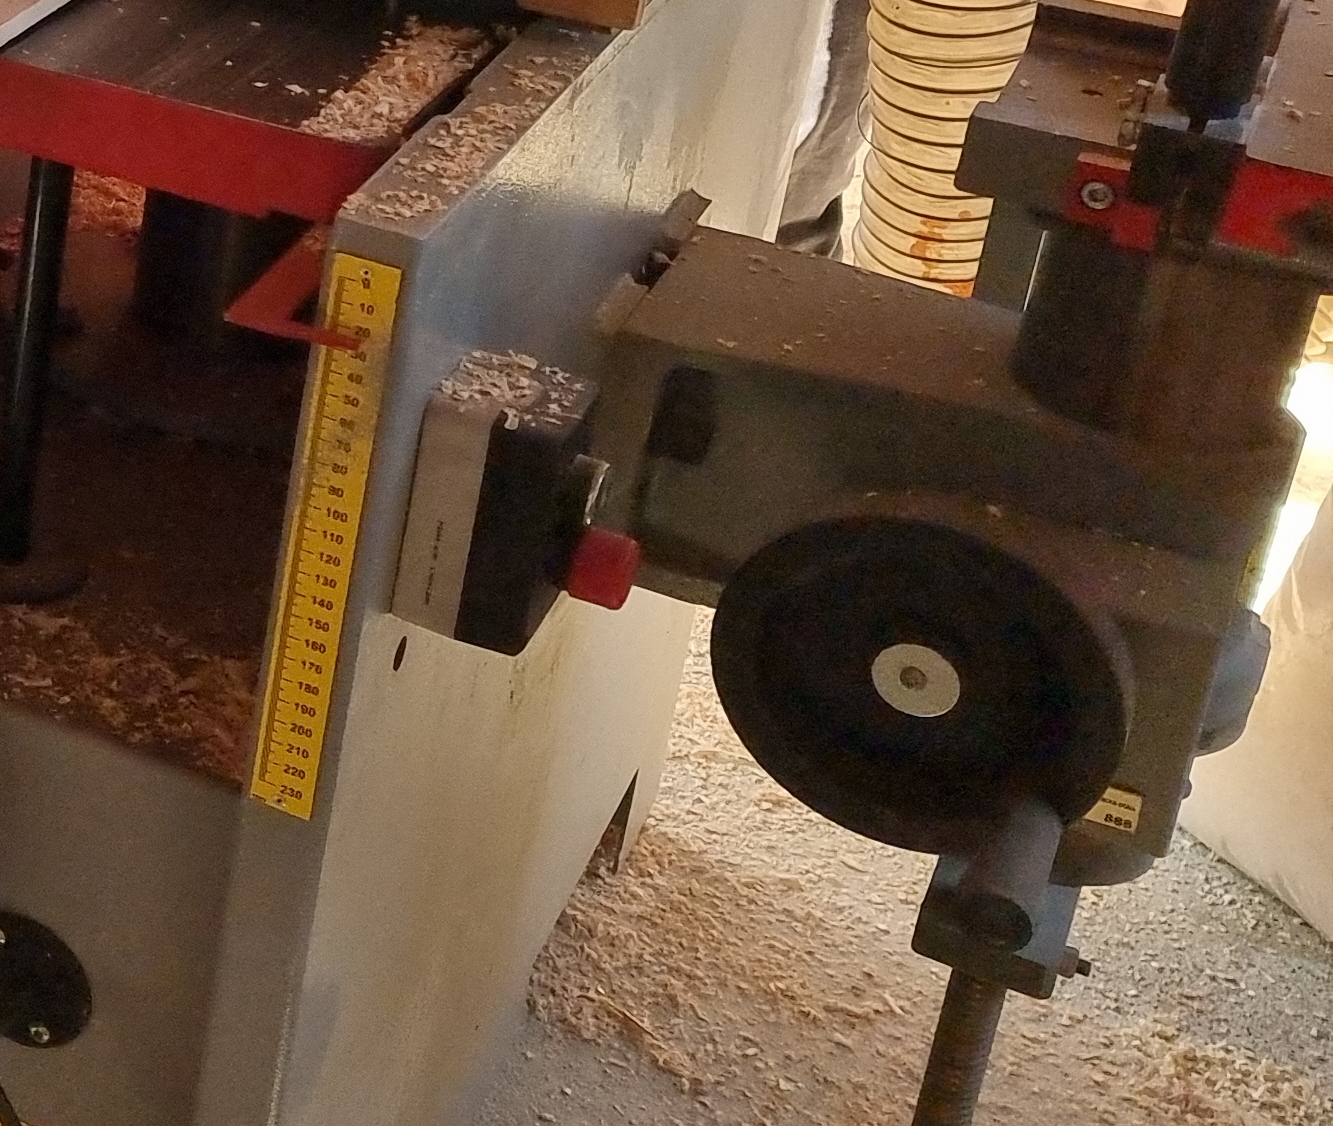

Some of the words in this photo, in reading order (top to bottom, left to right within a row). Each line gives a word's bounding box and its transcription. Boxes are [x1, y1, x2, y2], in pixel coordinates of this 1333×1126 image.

[359, 302, 375, 315] 10
[327, 507, 348, 523] 100
[323, 530, 344, 545] 110
[320, 552, 341, 567] 120
[315, 574, 337, 589] 130
[312, 596, 334, 611] 140
[308, 617, 330, 632] 150
[304, 639, 327, 654] 160
[301, 660, 323, 675] 170
[297, 681, 320, 696] 180
[294, 702, 316, 718] 190
[290, 723, 313, 738] 200
[286, 744, 309, 759] 210
[283, 764, 306, 780] 220
[279, 785, 303, 800] 230
